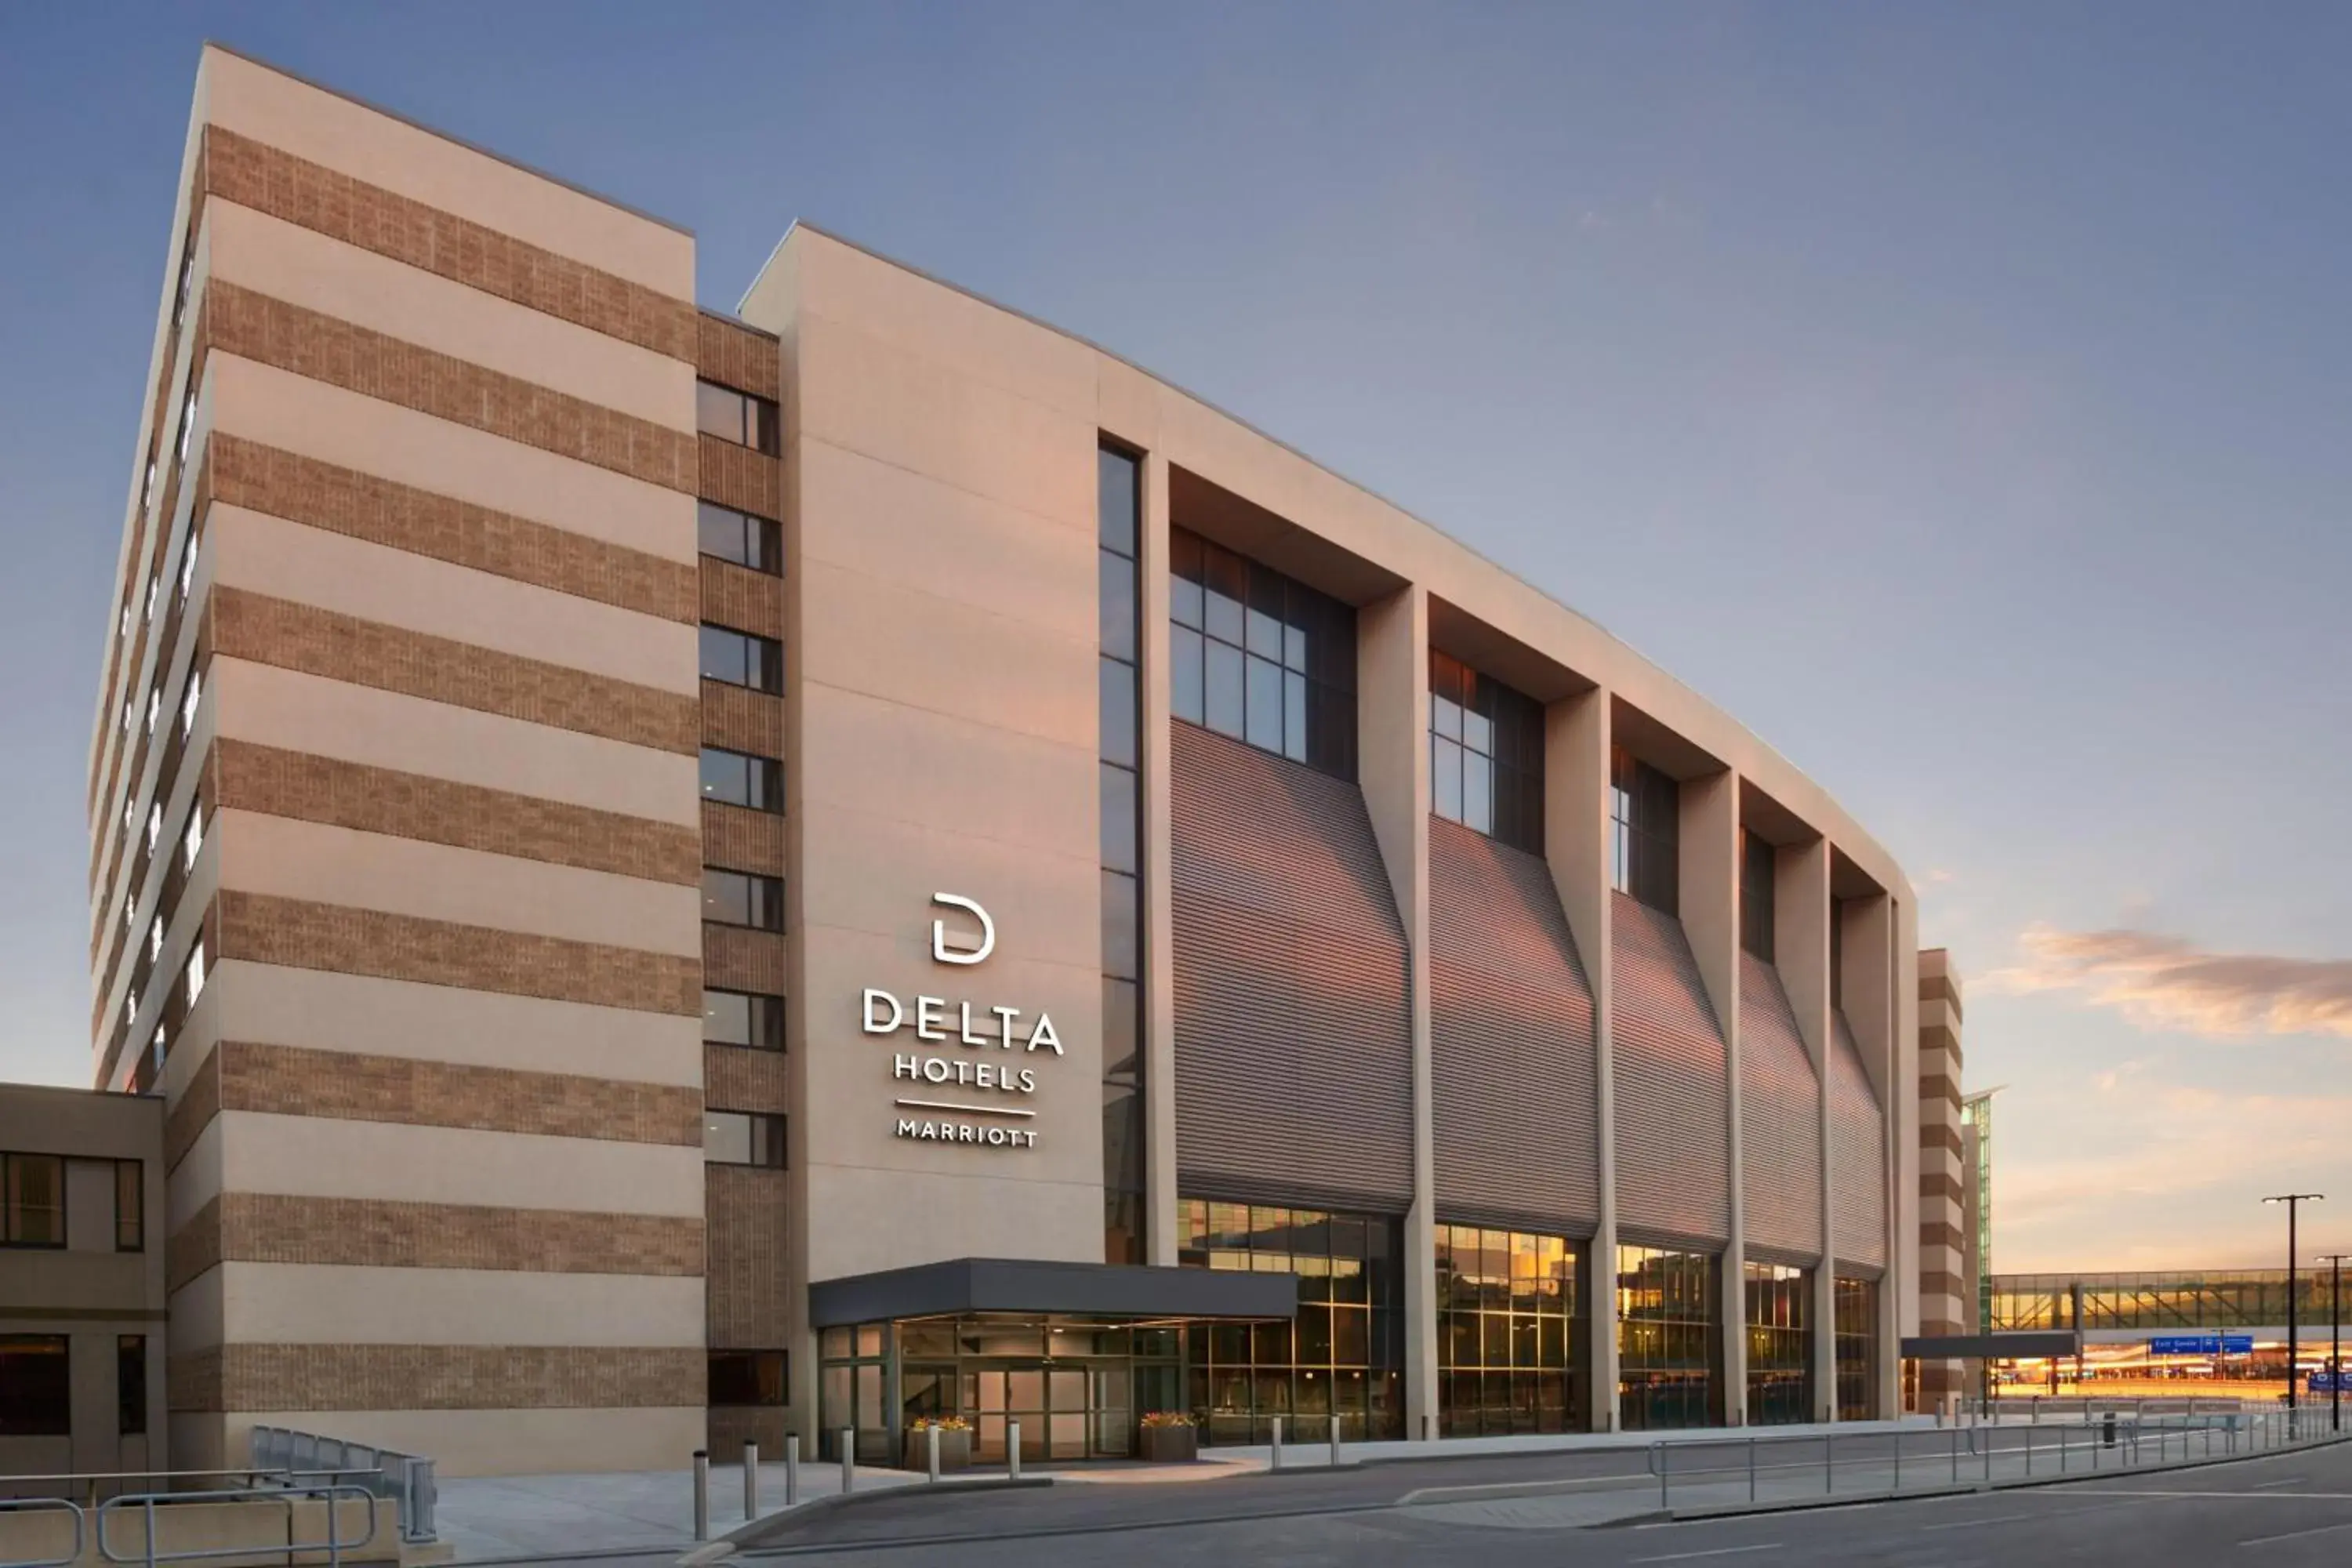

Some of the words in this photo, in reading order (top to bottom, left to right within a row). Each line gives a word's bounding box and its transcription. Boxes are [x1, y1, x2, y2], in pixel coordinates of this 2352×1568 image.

[862, 989, 1064, 1055] DELTA
[894, 1054, 1035, 1092] HOTELS
[897, 1120, 1037, 1148] MARRIOTT
